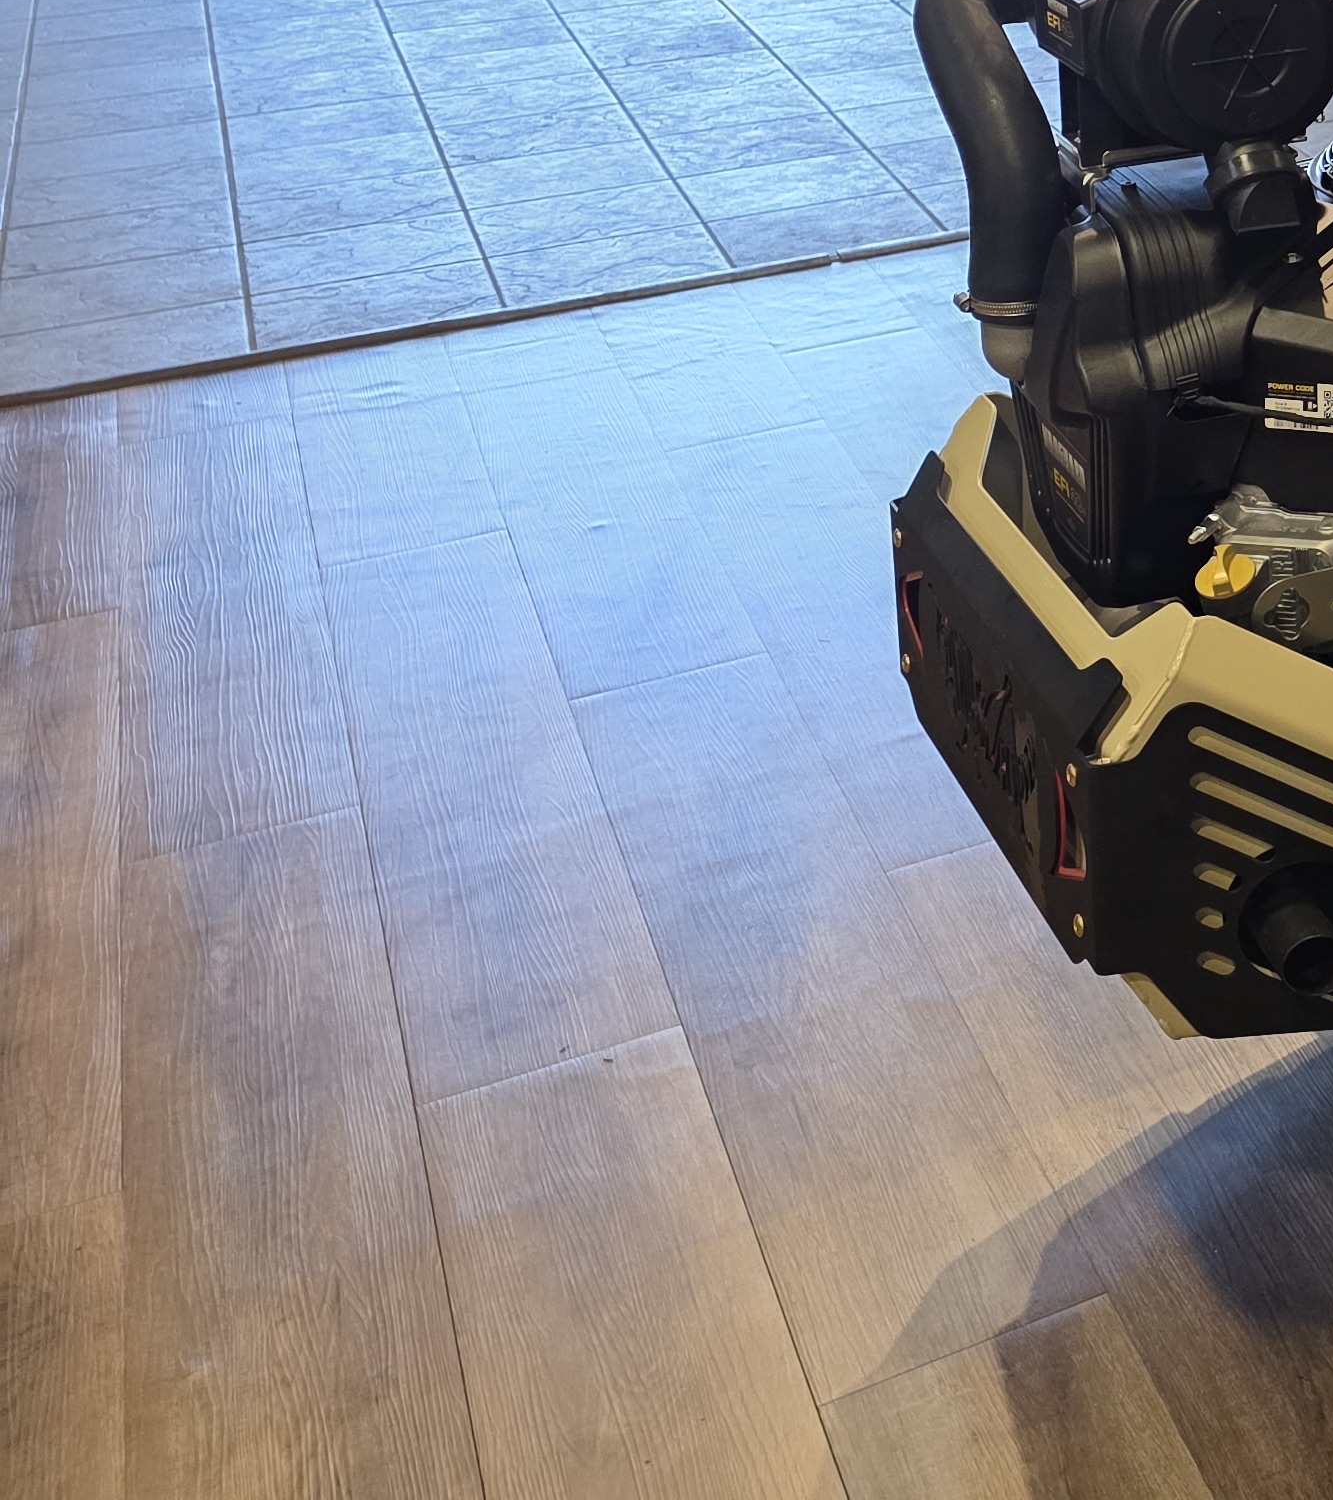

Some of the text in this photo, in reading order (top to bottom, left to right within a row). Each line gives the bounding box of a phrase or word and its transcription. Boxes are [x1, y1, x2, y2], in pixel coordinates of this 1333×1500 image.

[1046, 10, 1061, 32] EFI
[1267, 382, 1315, 393] POWER CODE
[1053, 466, 1070, 499] EFI
